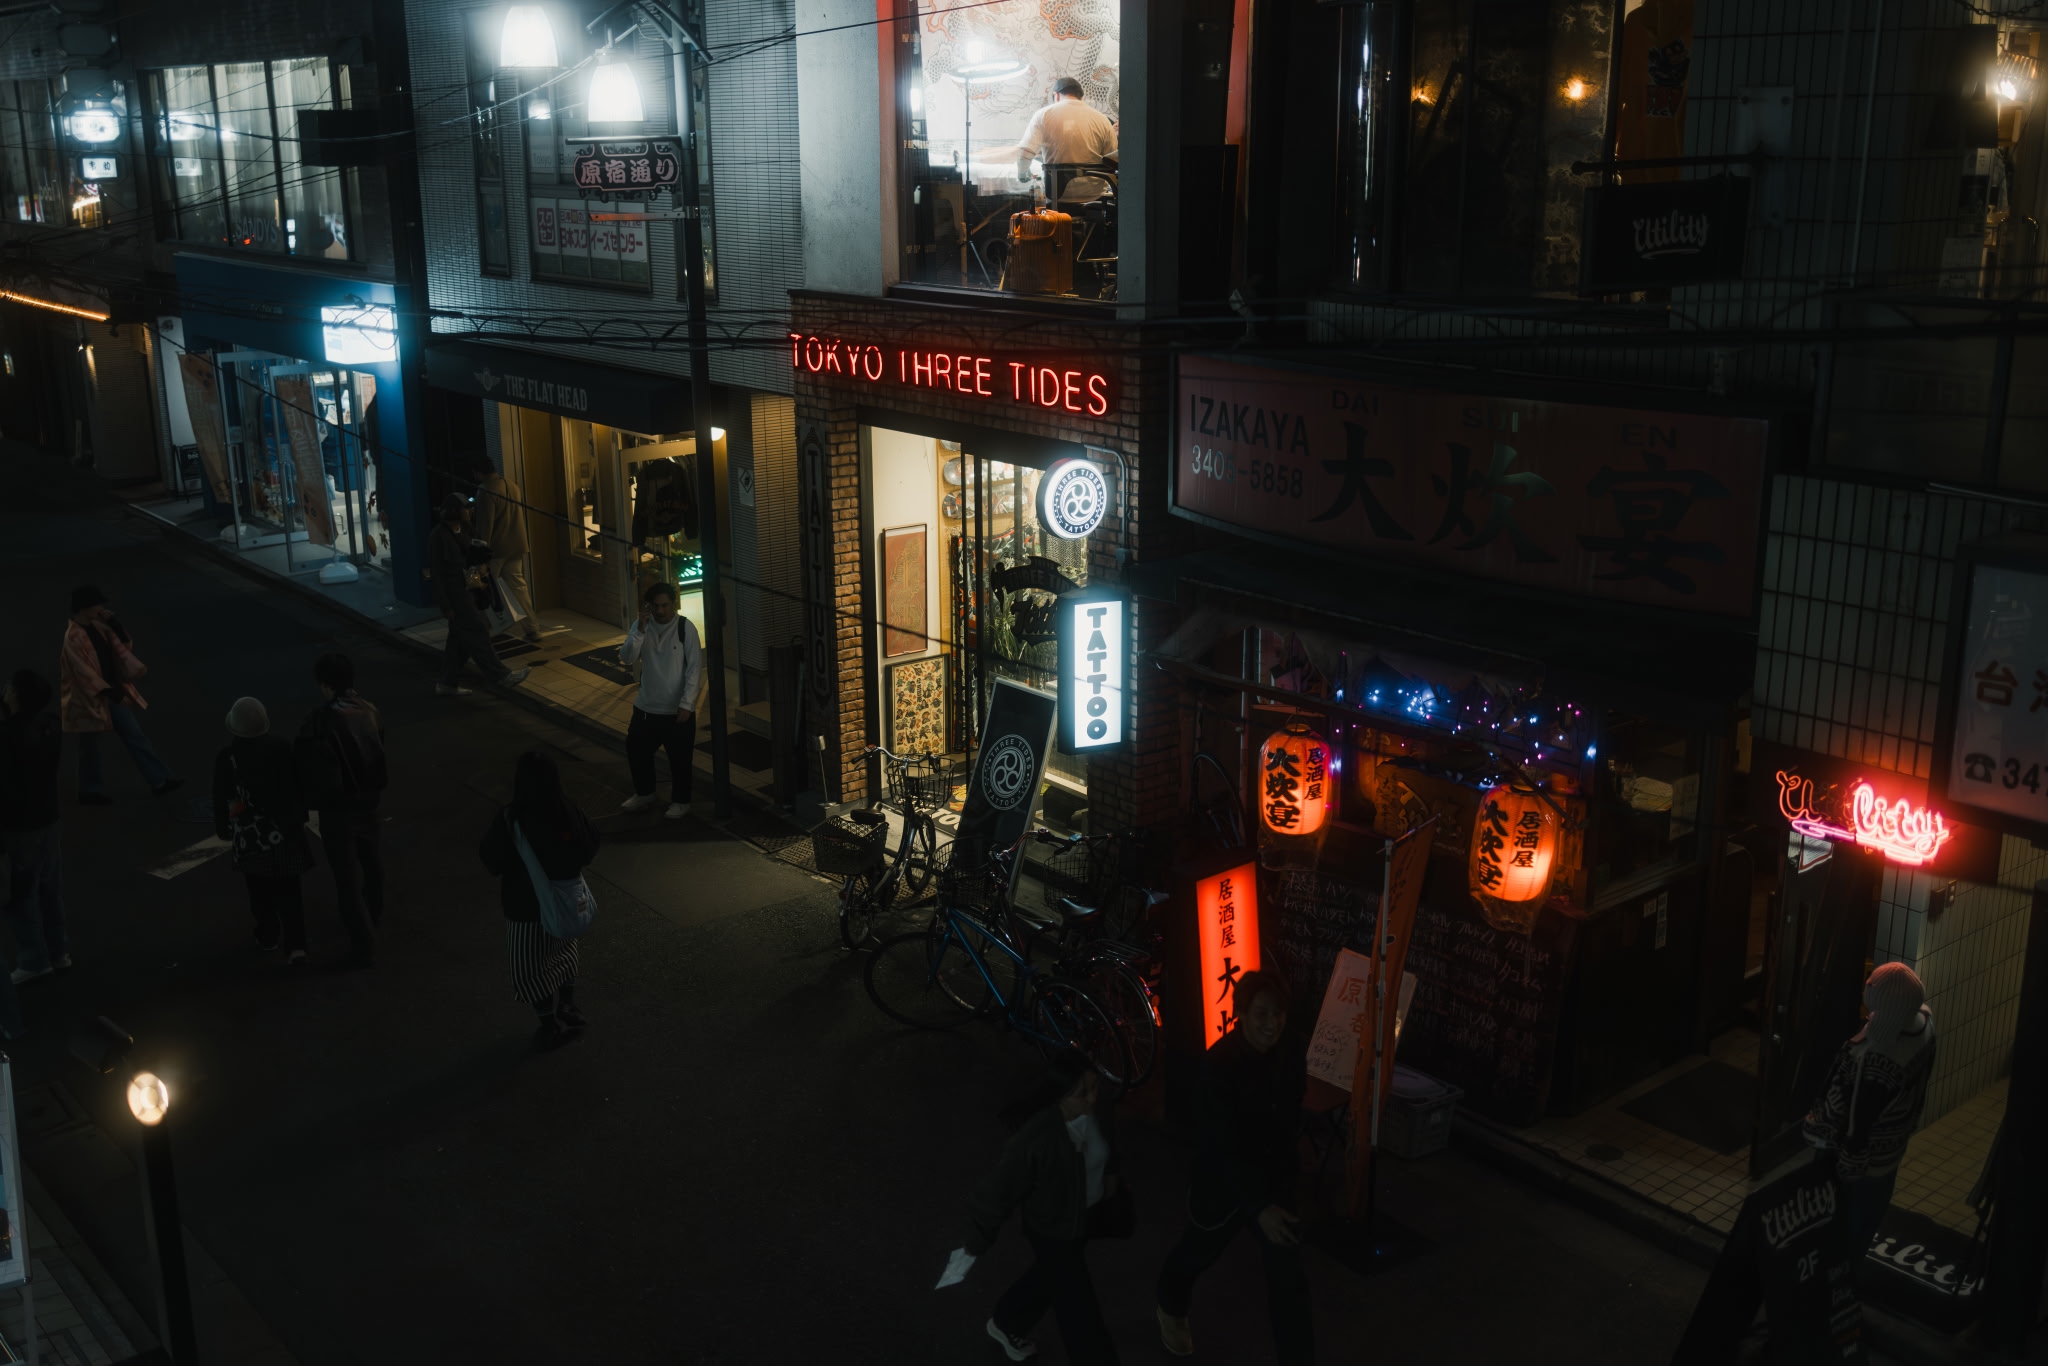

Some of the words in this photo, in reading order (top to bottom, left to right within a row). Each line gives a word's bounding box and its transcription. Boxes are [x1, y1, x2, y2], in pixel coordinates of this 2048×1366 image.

[580, 158, 674, 184] 原宿通り
[1632, 209, 1711, 254] Utility
[504, 374, 526, 399] THE
[528, 378, 555, 406] FLAT
[557, 383, 588, 411] HEAD
[789, 333, 883, 381] TOKYO
[901, 350, 992, 396] THREE
[1008, 362, 1108, 416] TIDES
[1191, 394, 1310, 457] IZAKAYA
[1332, 389, 1380, 416] DAI
[1462, 407, 1520, 434] SUI
[1621, 422, 1679, 450] EN
[1057, 471, 1077, 497] THREE
[1081, 469, 1102, 490] TIDES
[1191, 444, 1304, 499] 3405-5858
[1064, 518, 1096, 533] TATTOO
[1087, 607, 1107, 740] TATTOO
[990, 738, 1015, 758] THREE
[1018, 741, 1032, 770] TIDES
[1303, 747, 1325, 801] 居酒屋
[988, 789, 1015, 807] TATTOO
[1510, 811, 1542, 869] 居酒屋
[1218, 878, 1236, 949] 居酒屋
[1761, 1179, 1836, 1246] Utility
[1797, 1248, 1820, 1284] 2F
